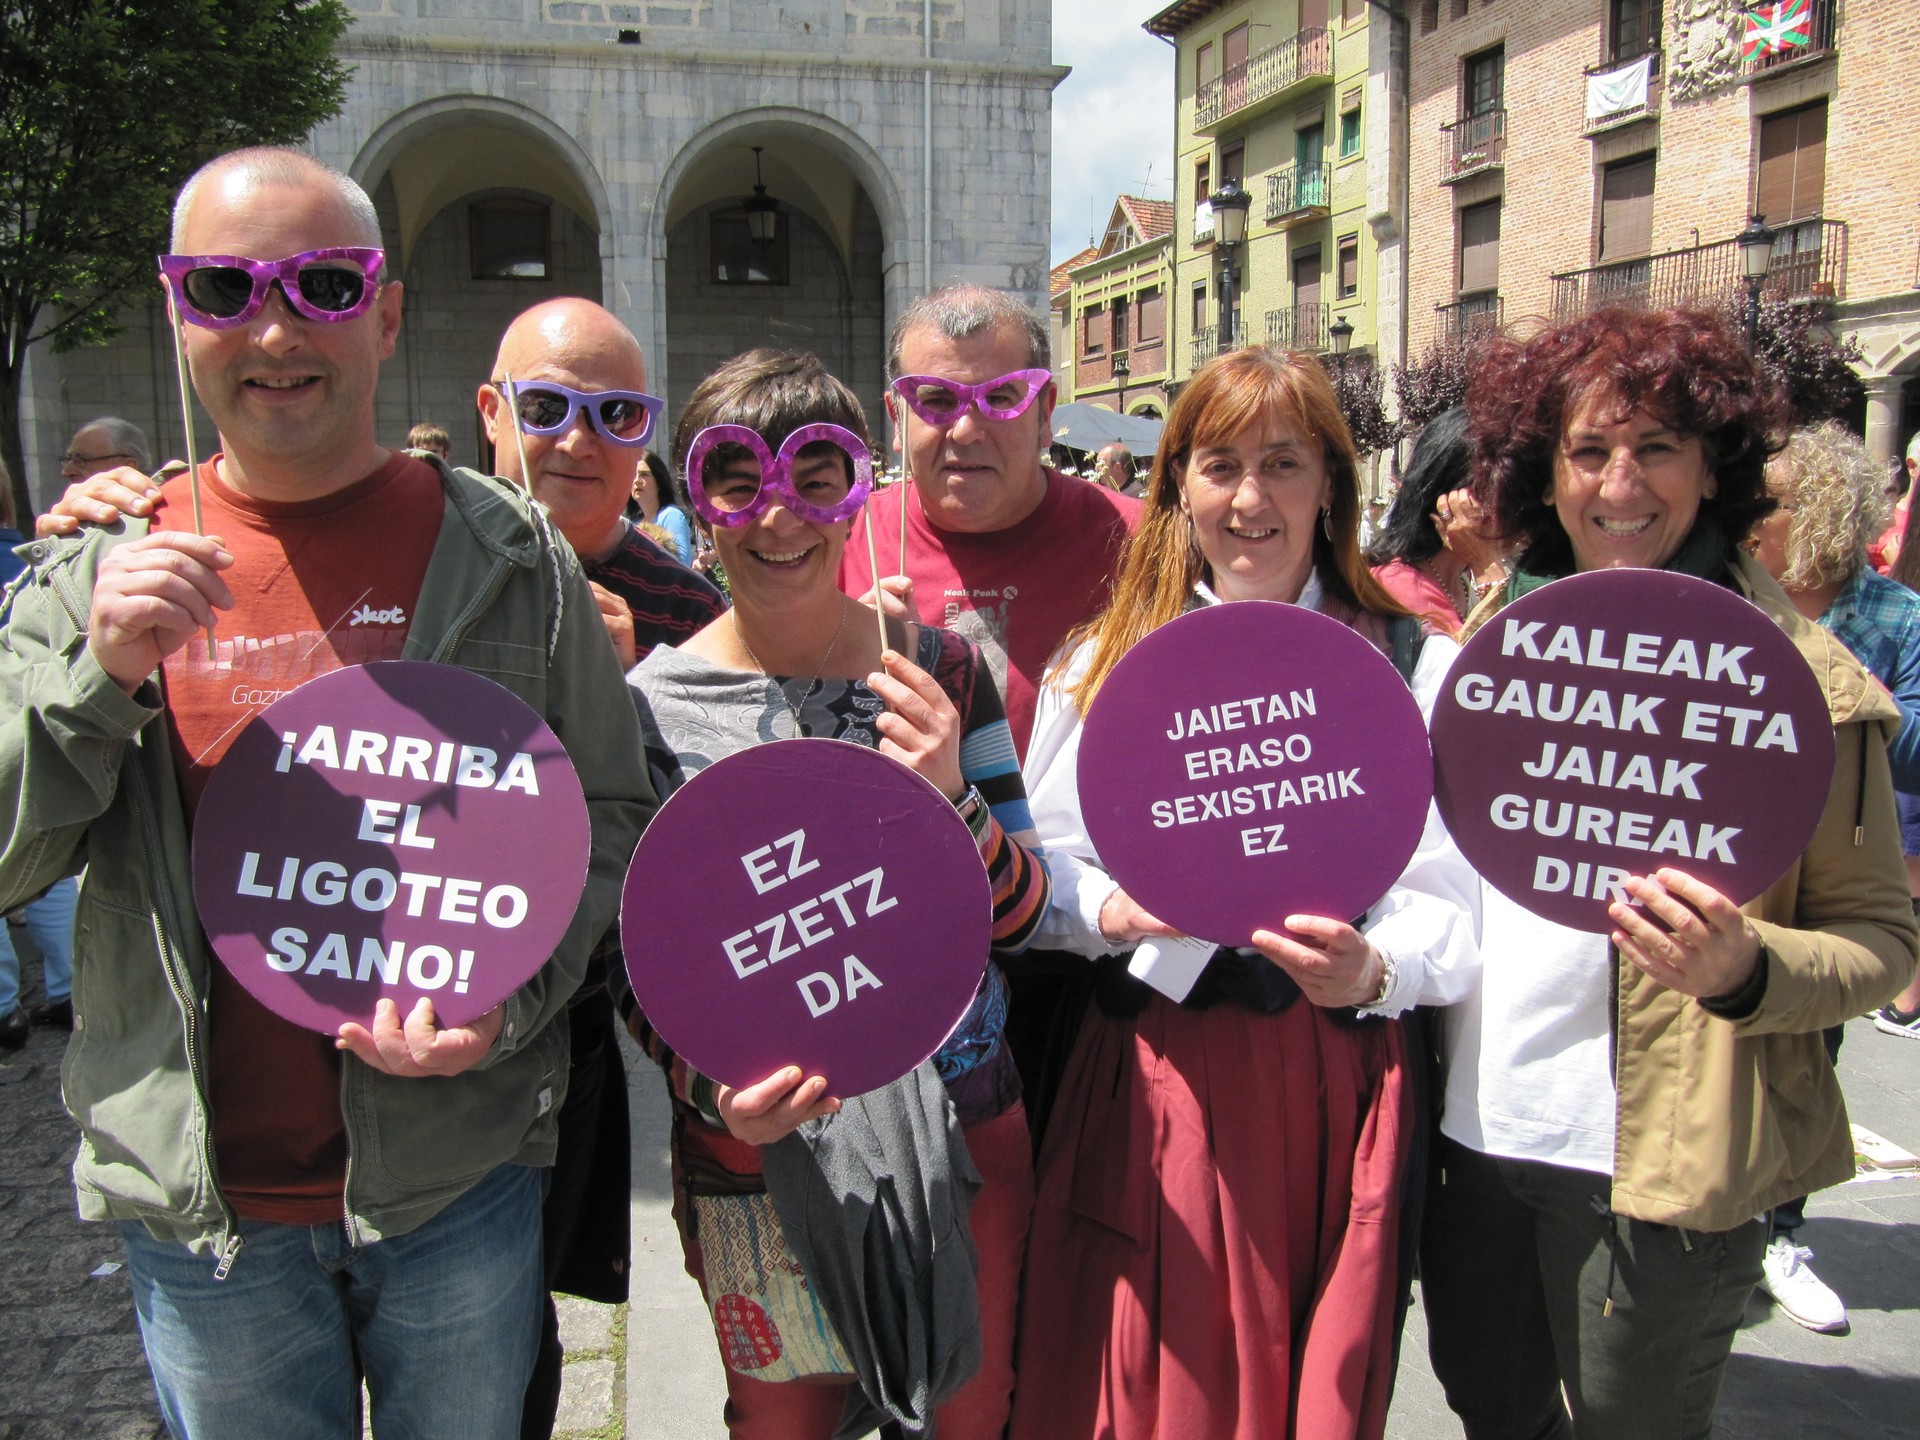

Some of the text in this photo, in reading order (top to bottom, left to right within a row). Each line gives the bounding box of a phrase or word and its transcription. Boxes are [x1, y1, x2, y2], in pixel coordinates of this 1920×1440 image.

[1501, 618, 1767, 695] KALEAK,
[1167, 688, 1317, 740] JAIETAN
[1455, 674, 1798, 753] GAUAK ETA
[275, 723, 542, 798] ¡ARRIBA
[1185, 735, 1312, 780] ERASO
[1523, 742, 1708, 800] JAIAK
[357, 800, 436, 849] EL
[1151, 768, 1366, 828] SEXISTARIK
[1490, 794, 1743, 864] GUREAK
[740, 829, 820, 895] EZ
[1241, 823, 1289, 857] EZ
[236, 852, 530, 931] LIGOTEO
[721, 867, 898, 979] EZETZ
[264, 927, 476, 995] SANO!
[795, 954, 883, 1019] DA
